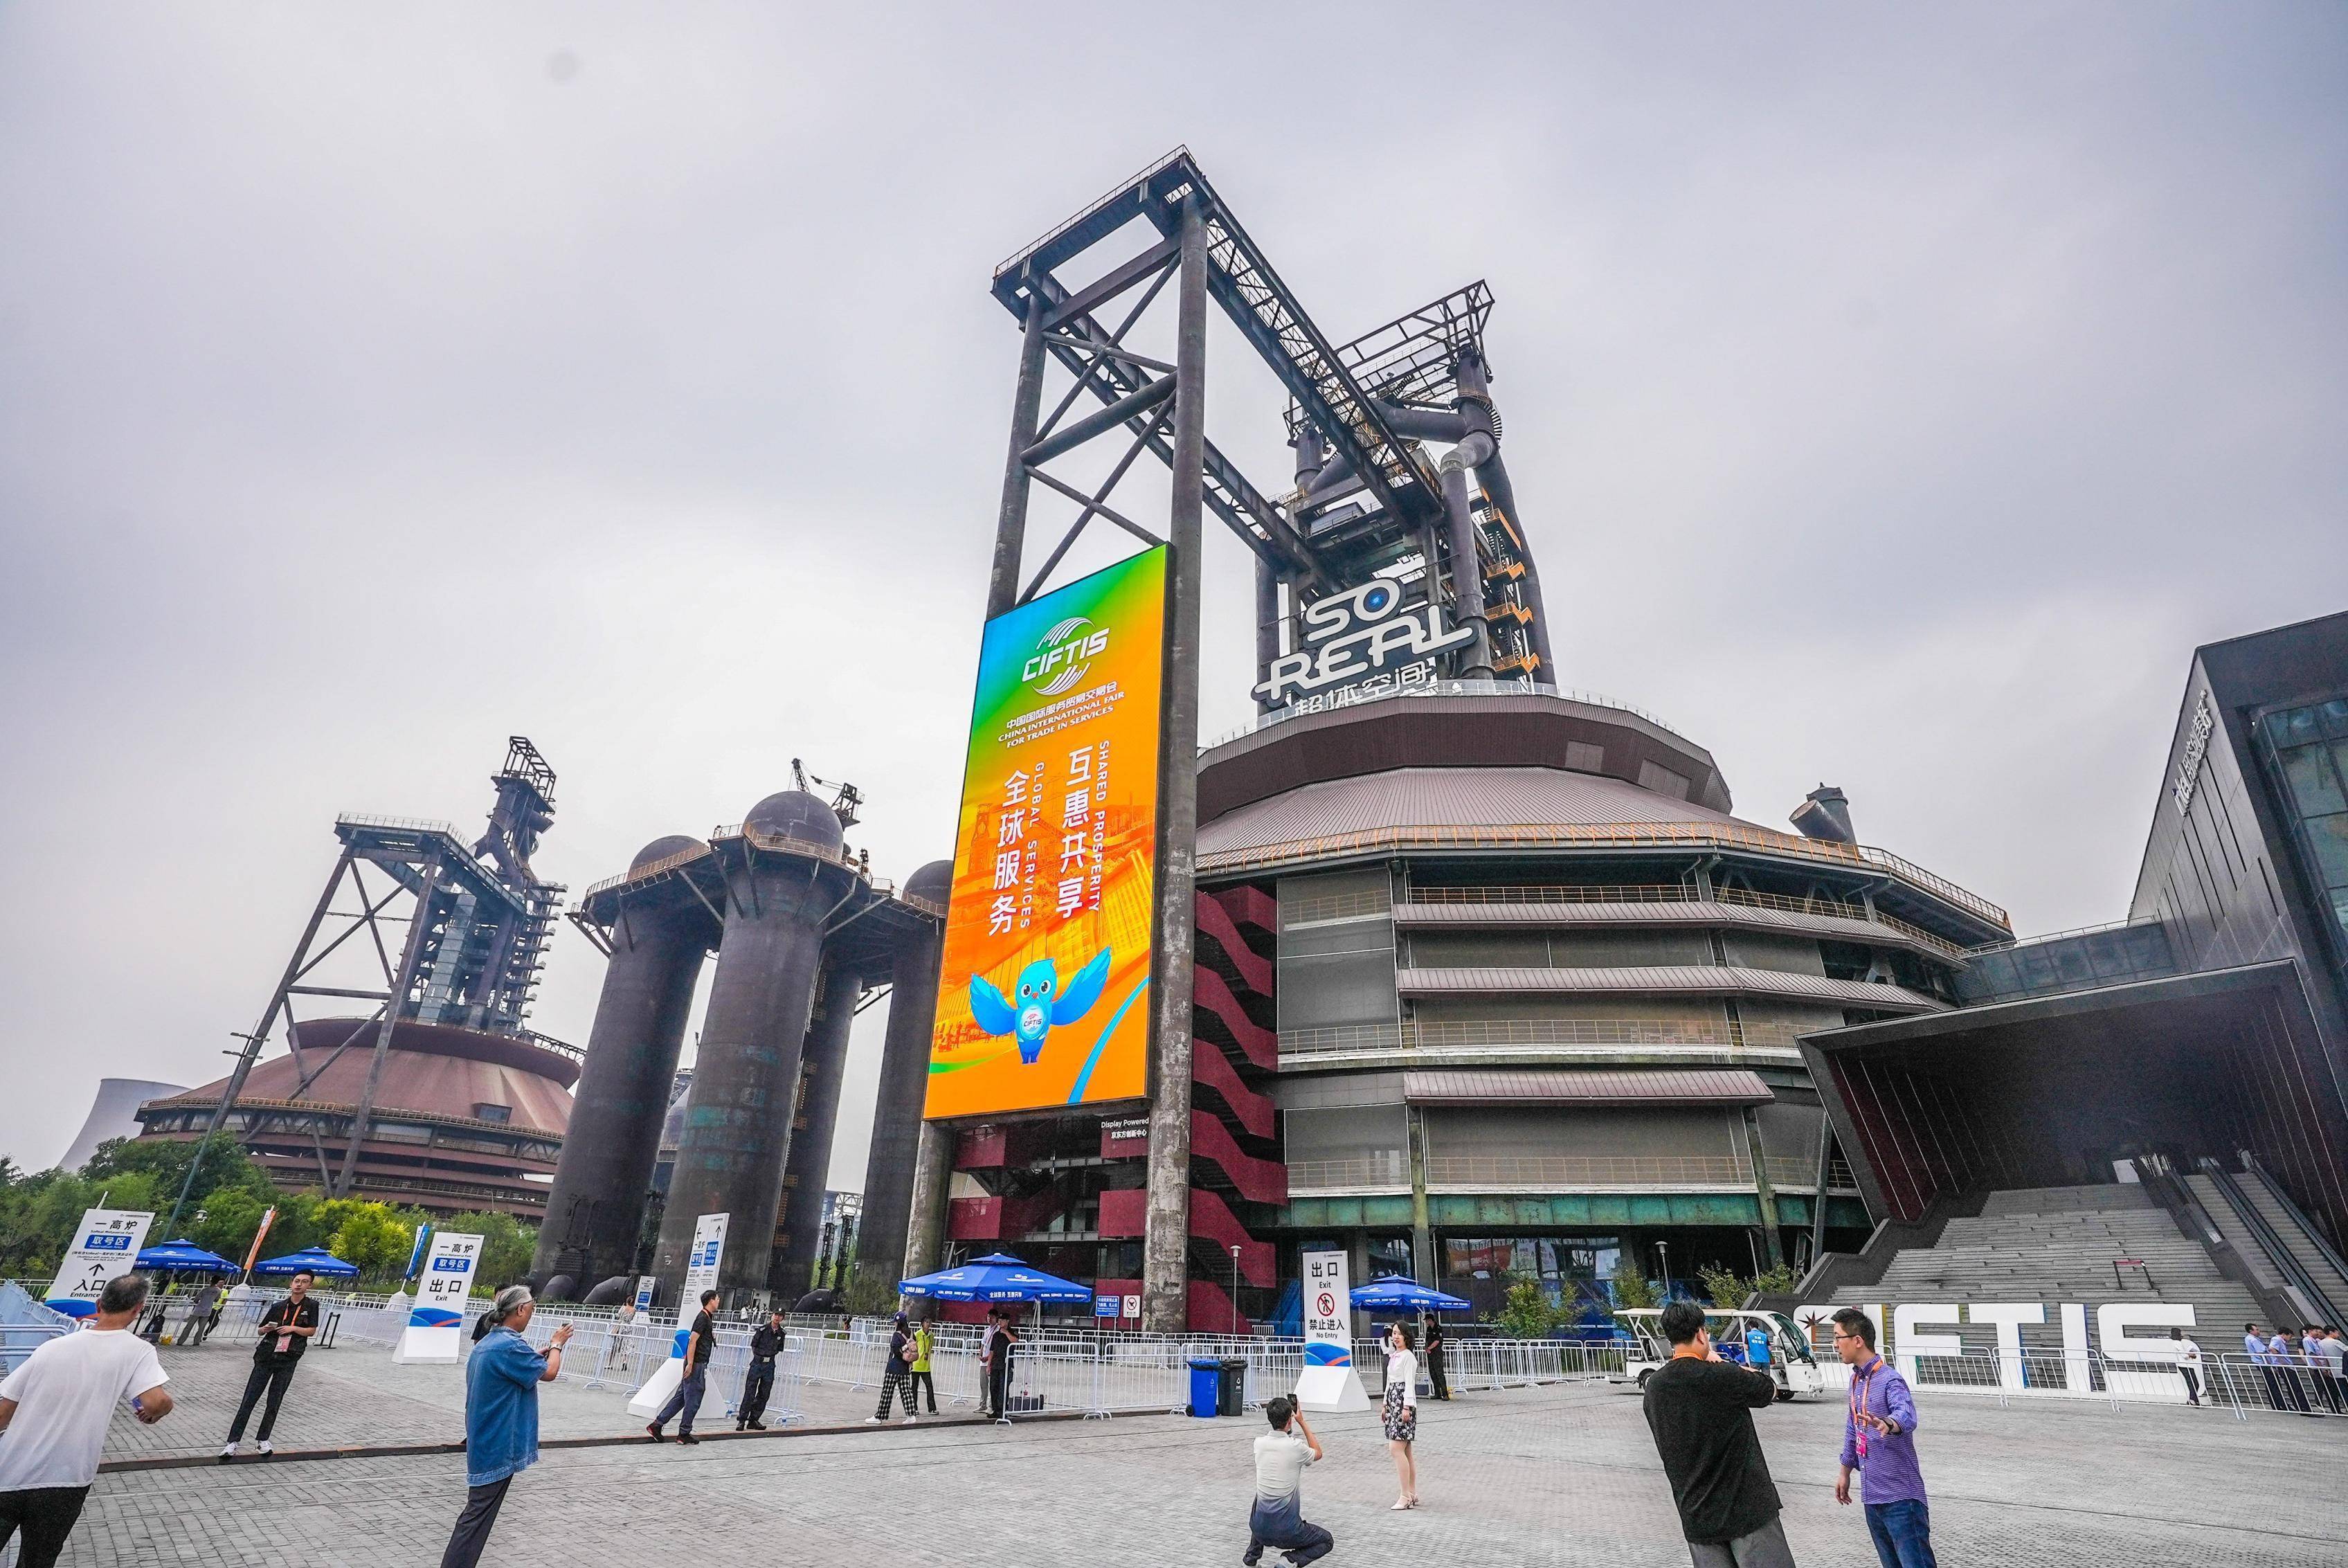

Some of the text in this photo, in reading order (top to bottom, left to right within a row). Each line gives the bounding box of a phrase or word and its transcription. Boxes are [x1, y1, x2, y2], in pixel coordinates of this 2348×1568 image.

[1306, 579, 1401, 642] SO
[1021, 627, 1110, 683] CIFTIS
[1254, 604, 1474, 700] REAL
[1006, 681, 1118, 730] 中国国际服务贸易交易会
[1294, 660, 1432, 717] 超体空间
[997, 691, 1125, 743] CHINA INTERNATIONAL FAIR
[1006, 705, 1114, 749] FOR TRADE IN SERVICES
[1020, 762, 1045, 929] GLOBAL SERVICES
[1056, 745, 1094, 919] 互惠共享
[1088, 740, 1110, 912] SHARED PROSPERITY
[988, 770, 1031, 937] 全球服务
[1024, 1018, 1042, 1027] CIFTIS
[1101, 1117, 1149, 1128] Display Powered
[91, 1236, 127, 1246] 取号区
[95, 1220, 138, 1230] 一高炉
[438, 1259, 467, 1268] 取号区
[440, 1243, 474, 1254] 一高炉
[1312, 1261, 1338, 1277] 出口
[73, 1279, 107, 1292] 入口
[429, 1278, 462, 1293] 出口
[1309, 1319, 1345, 1331] 禁止进入
[1793, 1303, 2206, 1398] CFTIS
